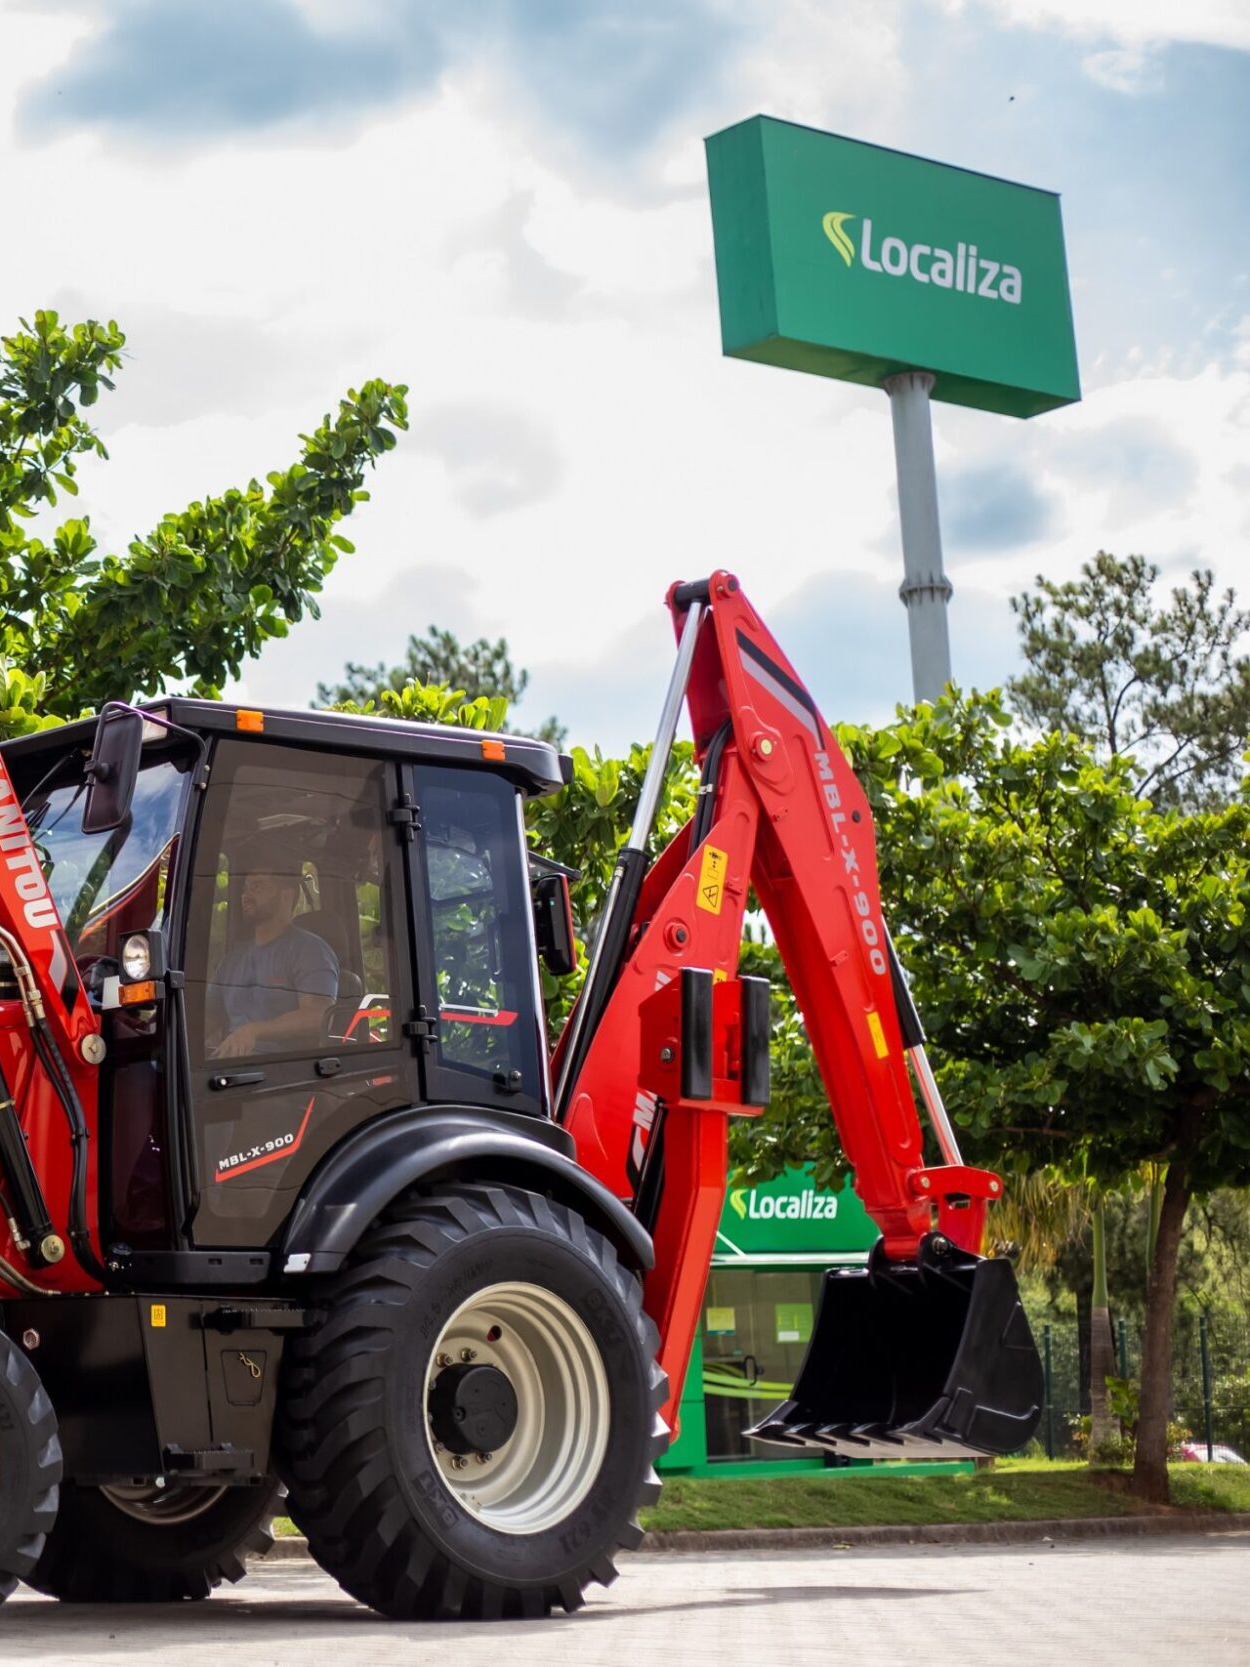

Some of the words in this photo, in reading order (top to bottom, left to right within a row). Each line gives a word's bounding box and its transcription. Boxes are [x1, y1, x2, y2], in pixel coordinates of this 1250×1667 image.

[860, 217, 1022, 305] Localiza
[813, 751, 887, 976] MBL-X-900
[218, 1132, 294, 1171] MBL-X-900
[748, 1188, 838, 1220] Localiza
